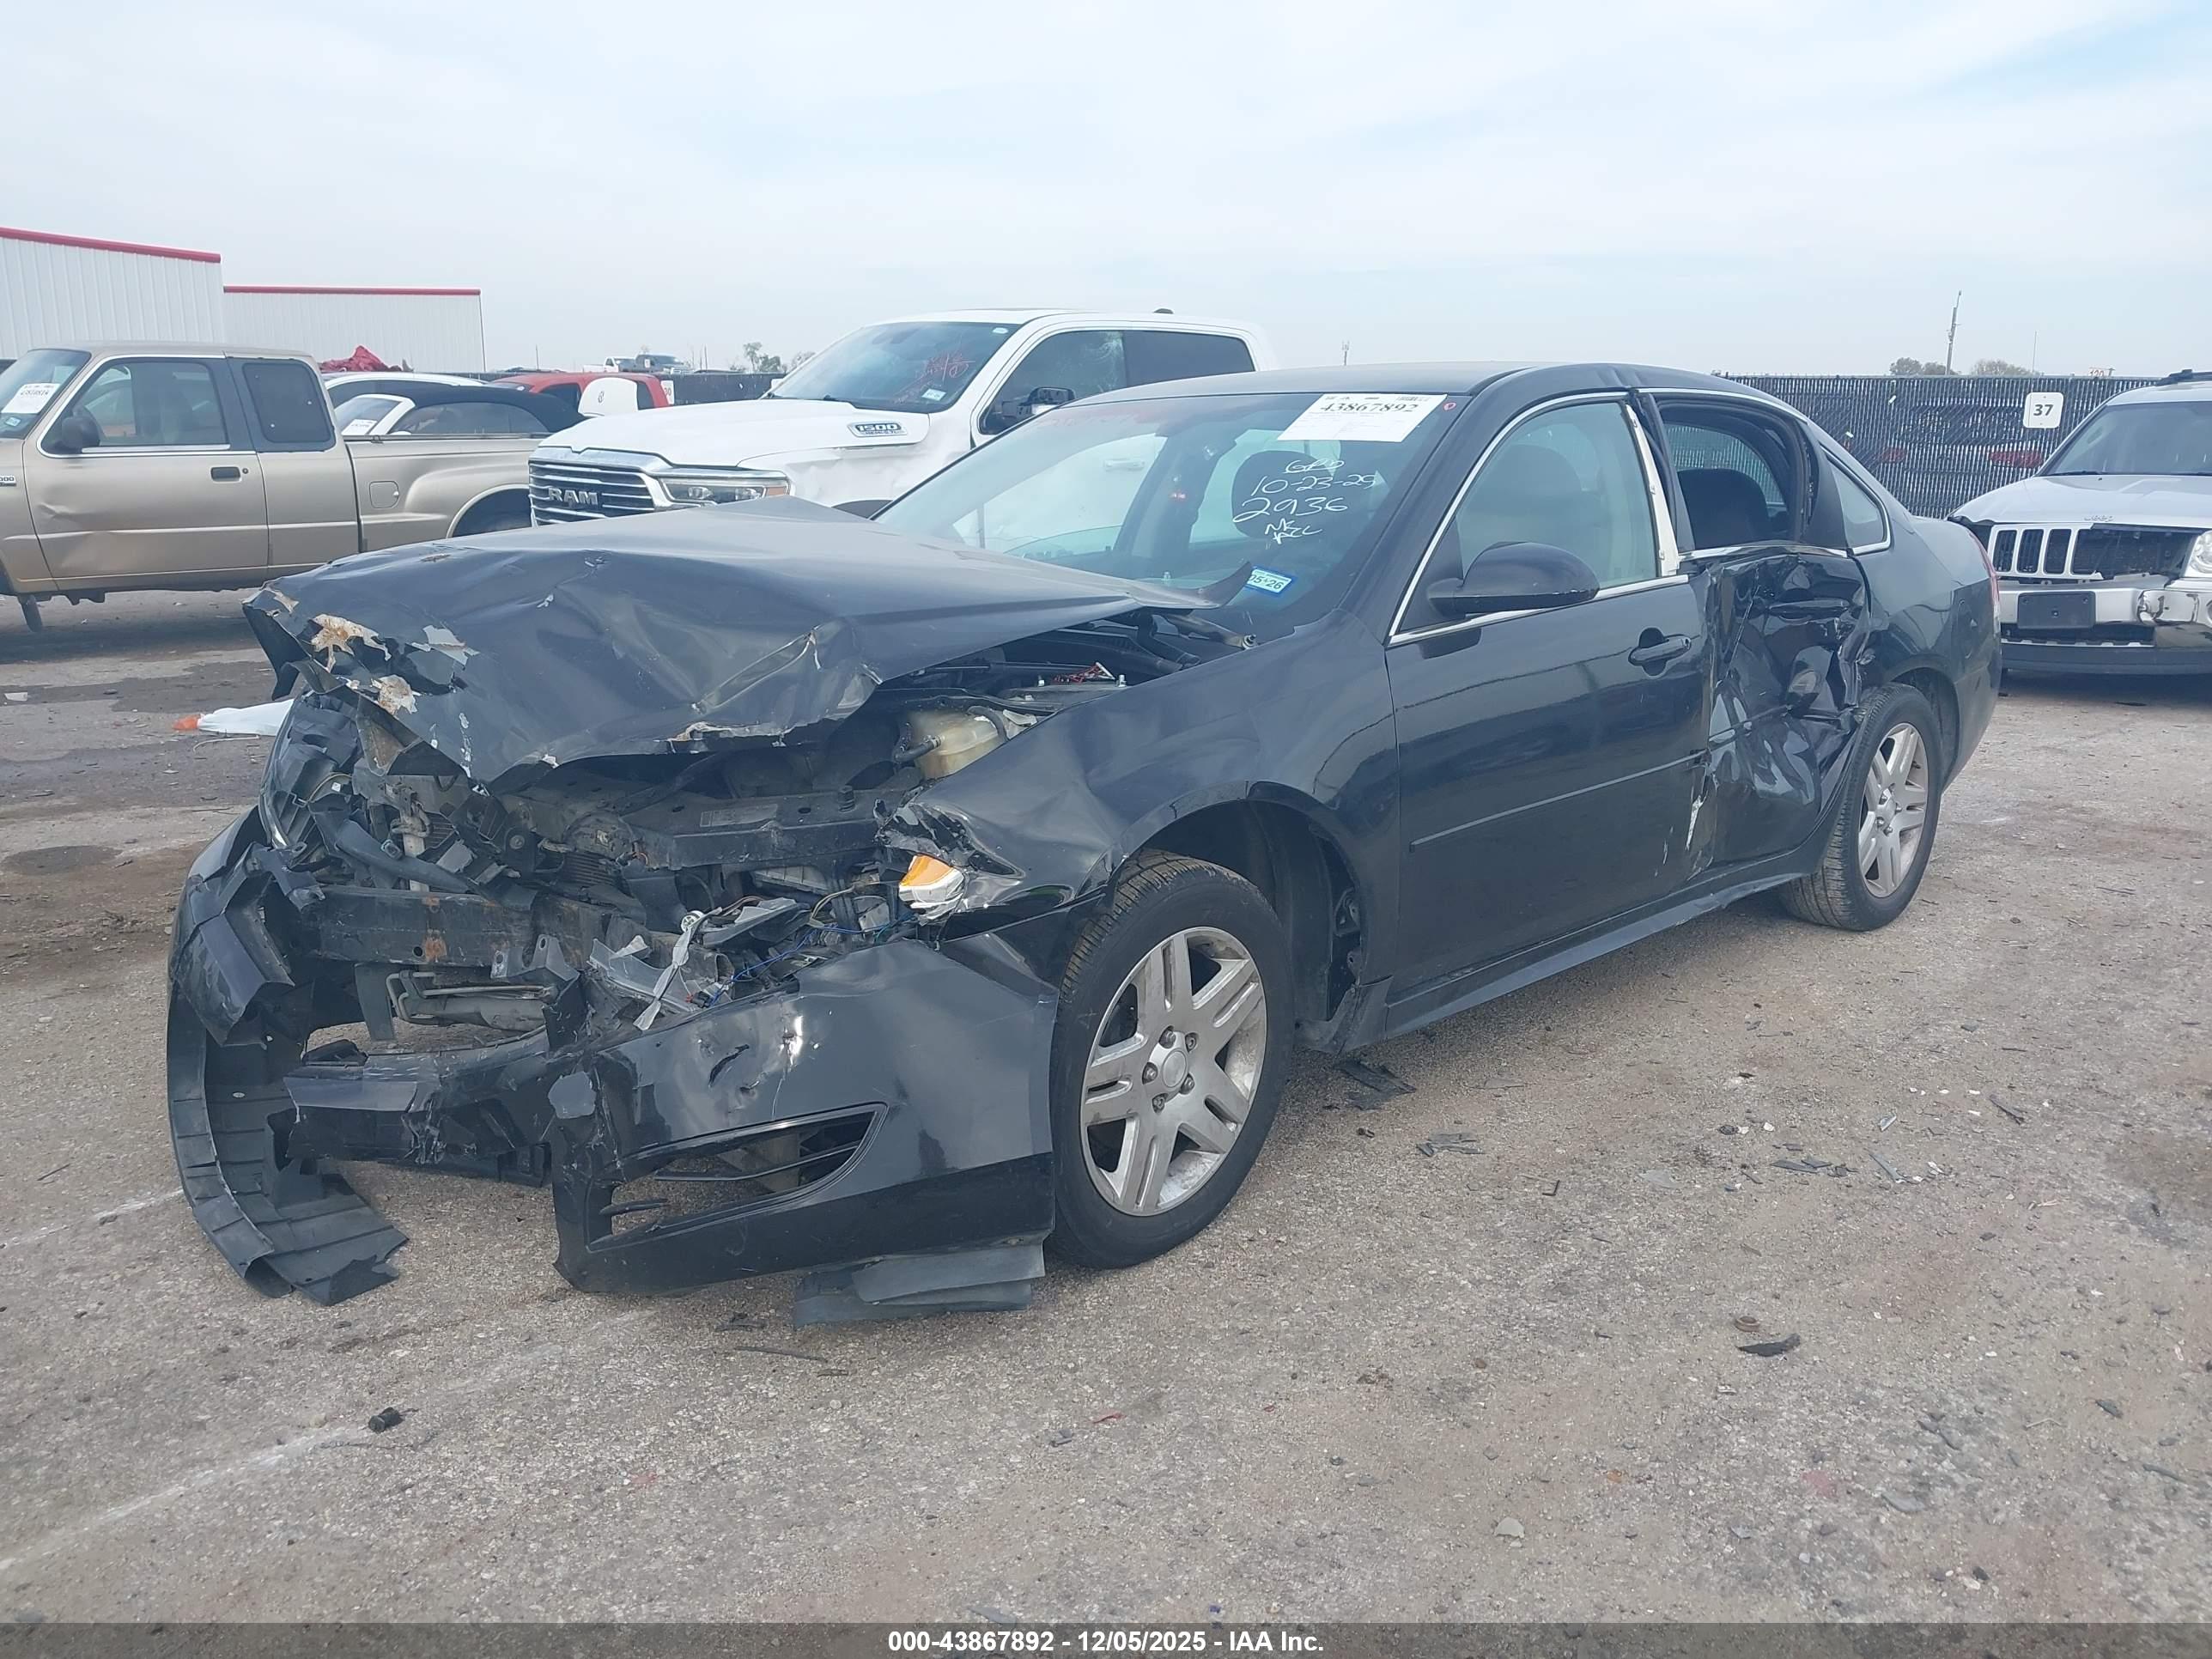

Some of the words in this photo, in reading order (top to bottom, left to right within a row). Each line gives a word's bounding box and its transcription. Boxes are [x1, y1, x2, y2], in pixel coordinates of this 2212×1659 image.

[1320, 403, 1419, 412] 43867892
[2033, 404, 2054, 416] 37
[548, 487, 599, 506] RAM
[1232, 497, 1348, 523] 2936
[1266, 580, 1285, 590] 26
